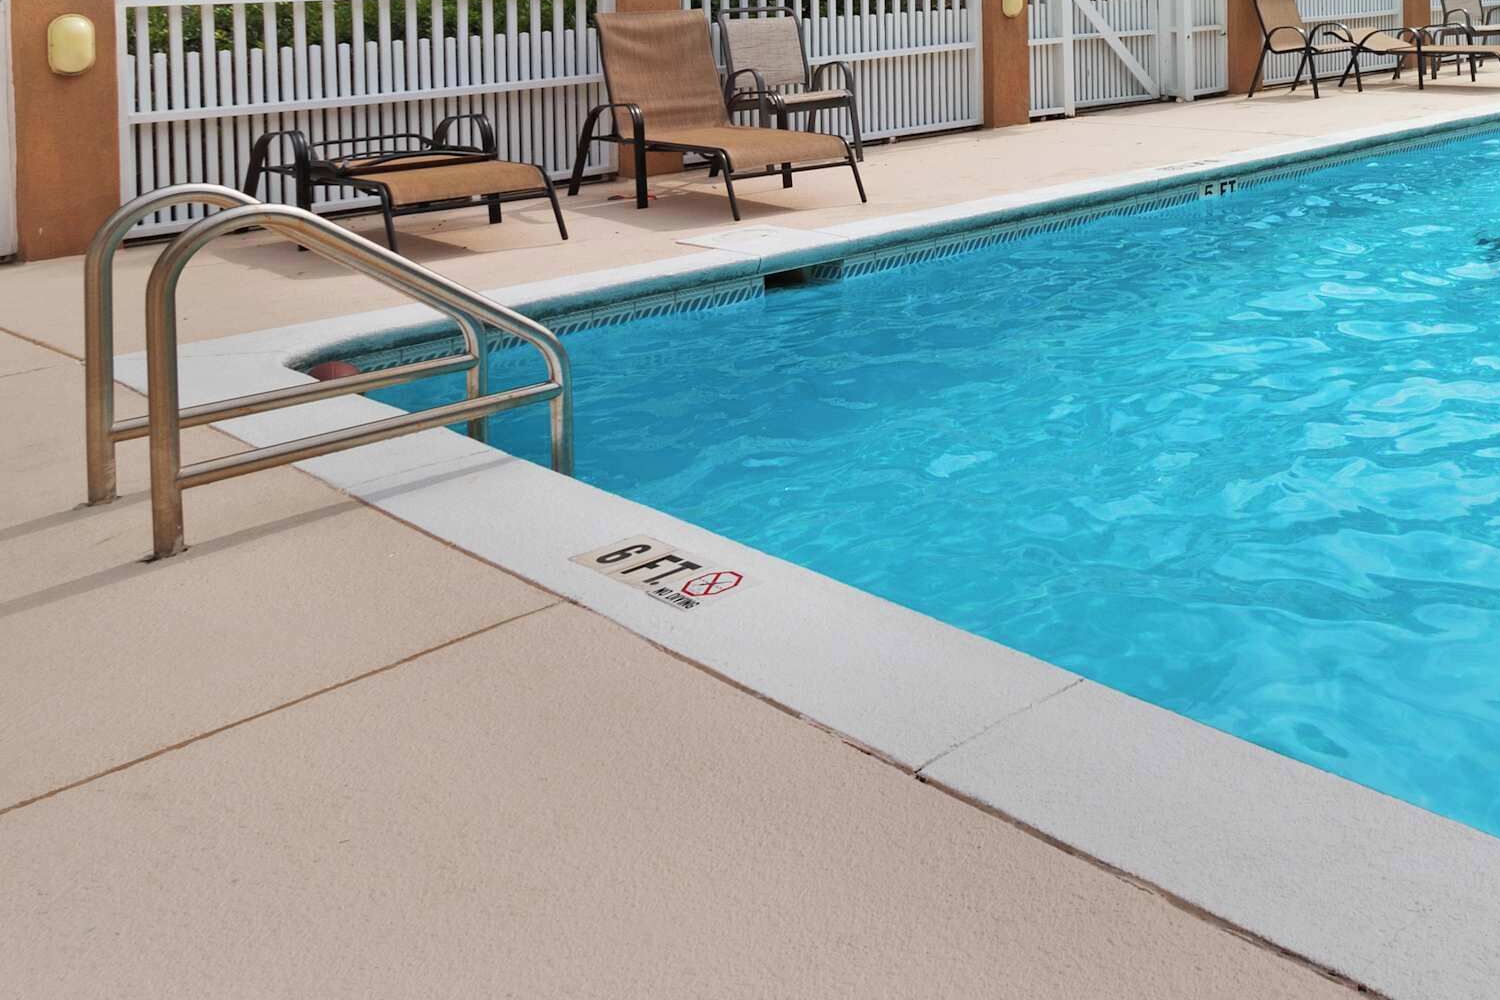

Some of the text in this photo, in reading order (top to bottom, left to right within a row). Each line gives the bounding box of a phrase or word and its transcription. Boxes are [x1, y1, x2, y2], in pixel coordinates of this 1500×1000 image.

[1220, 180, 1236, 196] FT
[596, 544, 652, 564] 6
[653, 587, 673, 596] NO
